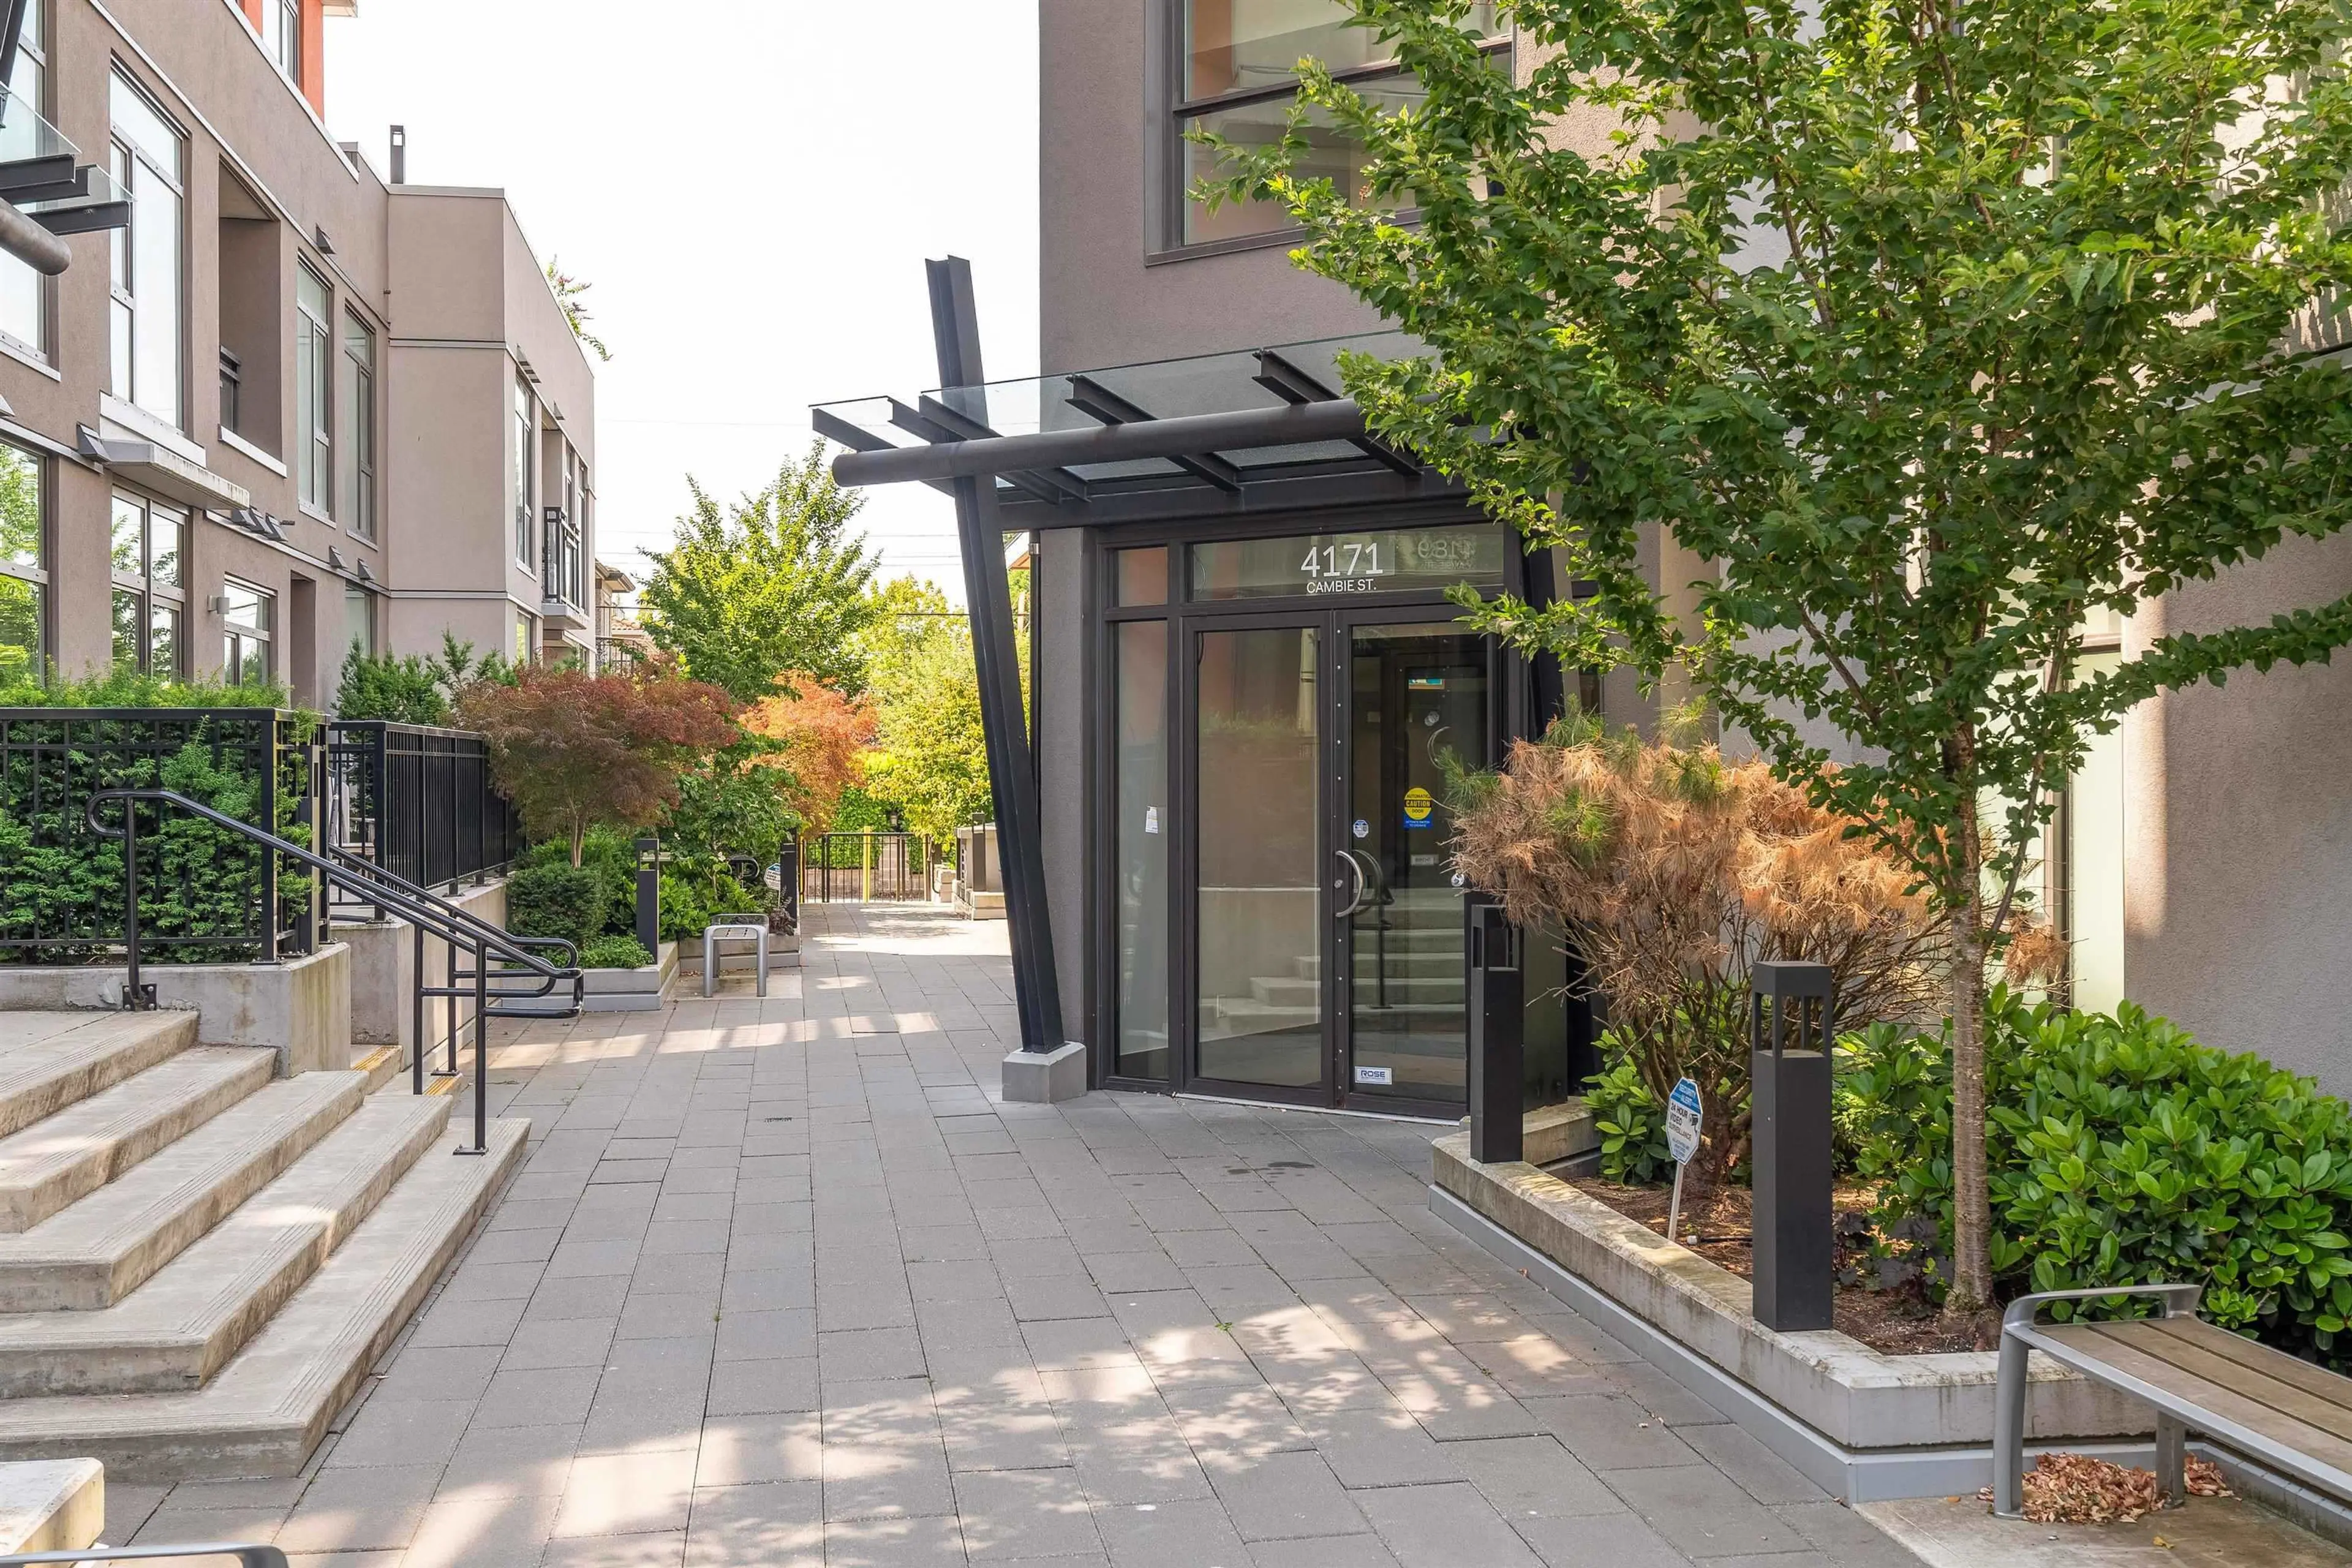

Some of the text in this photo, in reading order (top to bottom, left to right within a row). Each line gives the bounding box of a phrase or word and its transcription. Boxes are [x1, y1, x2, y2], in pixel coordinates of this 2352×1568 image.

[1301, 543, 1382, 577] 4171
[1306, 579, 1377, 593] CAMBIE ST.
[1671, 1102, 1688, 1118] 24 HOUR
[1670, 1112, 1682, 1125] VIDEO
